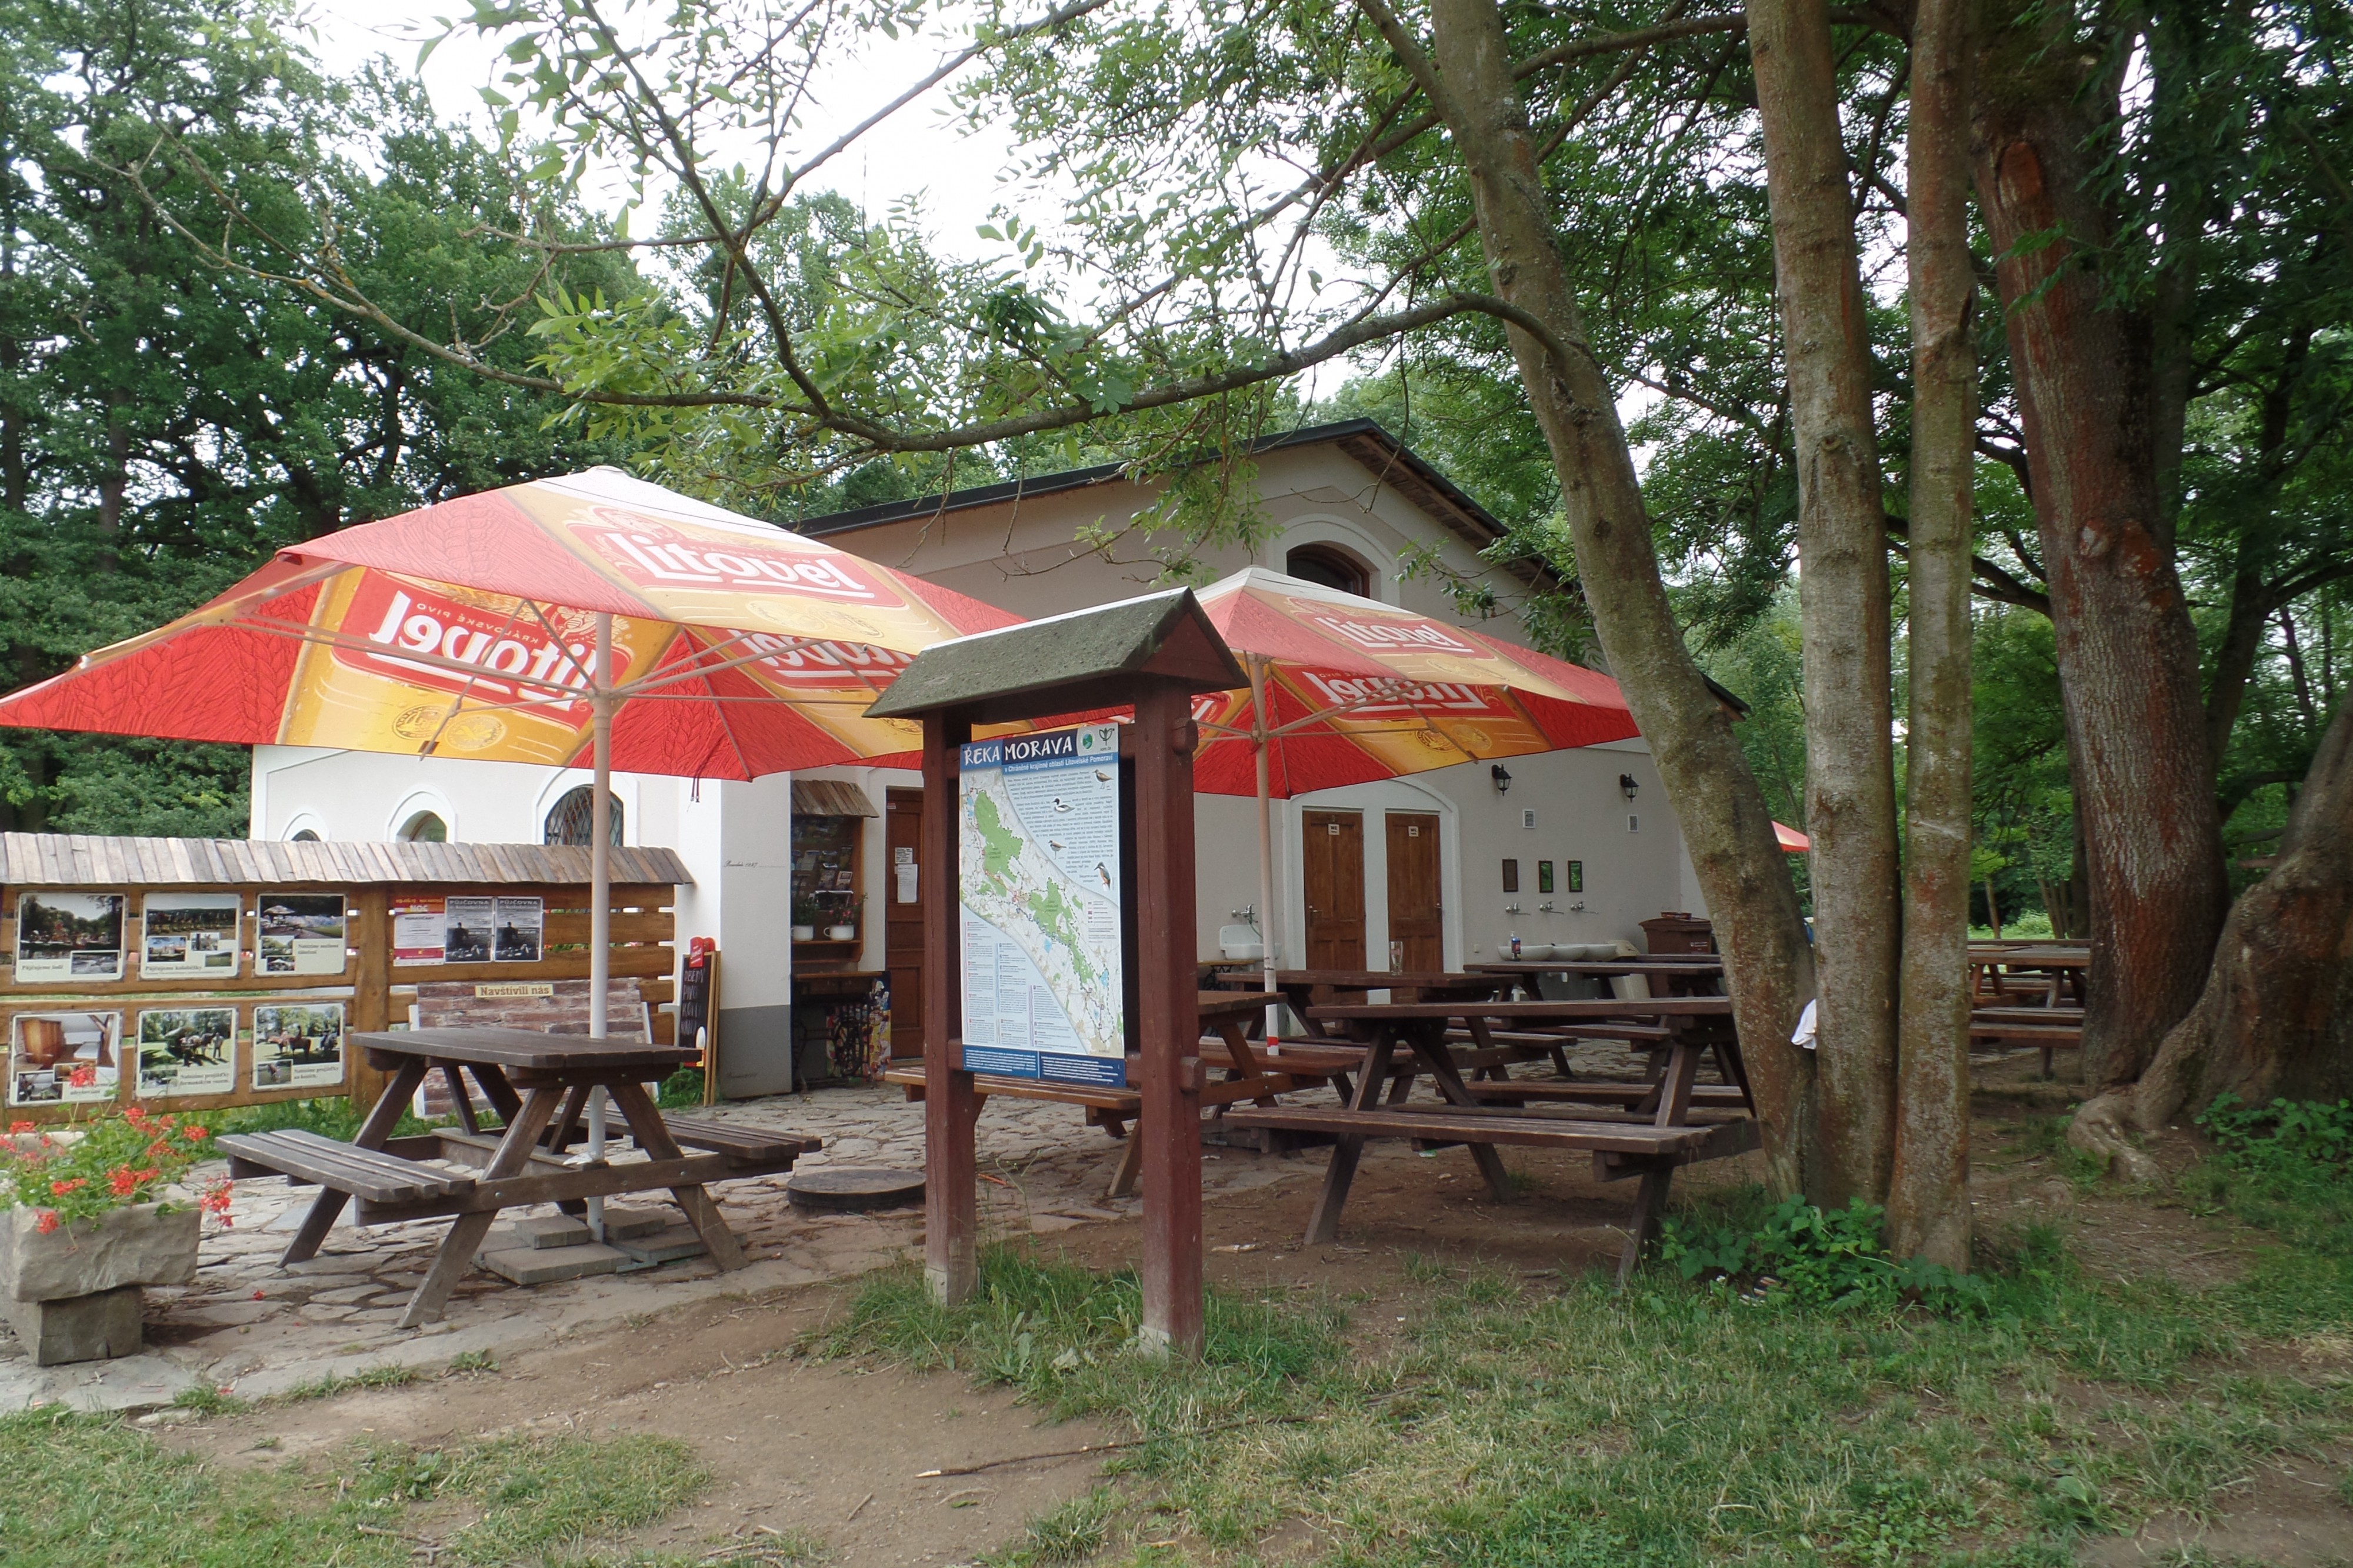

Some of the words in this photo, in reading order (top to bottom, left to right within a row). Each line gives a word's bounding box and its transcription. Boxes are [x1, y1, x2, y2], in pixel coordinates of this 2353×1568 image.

[604, 532, 875, 598] Litovel
[1315, 618, 1475, 653] Litovel
[964, 746, 1000, 765] ŘEKA
[1005, 736, 1073, 761] MORAVA
[1008, 763, 1029, 772] Chráněné
[1030, 762, 1048, 770] krajinné
[1065, 757, 1089, 766] Litovelské
[1090, 753, 1113, 763] Pomoraví
[480, 986, 528, 996] Navštívili
[531, 986, 549, 995] nás
